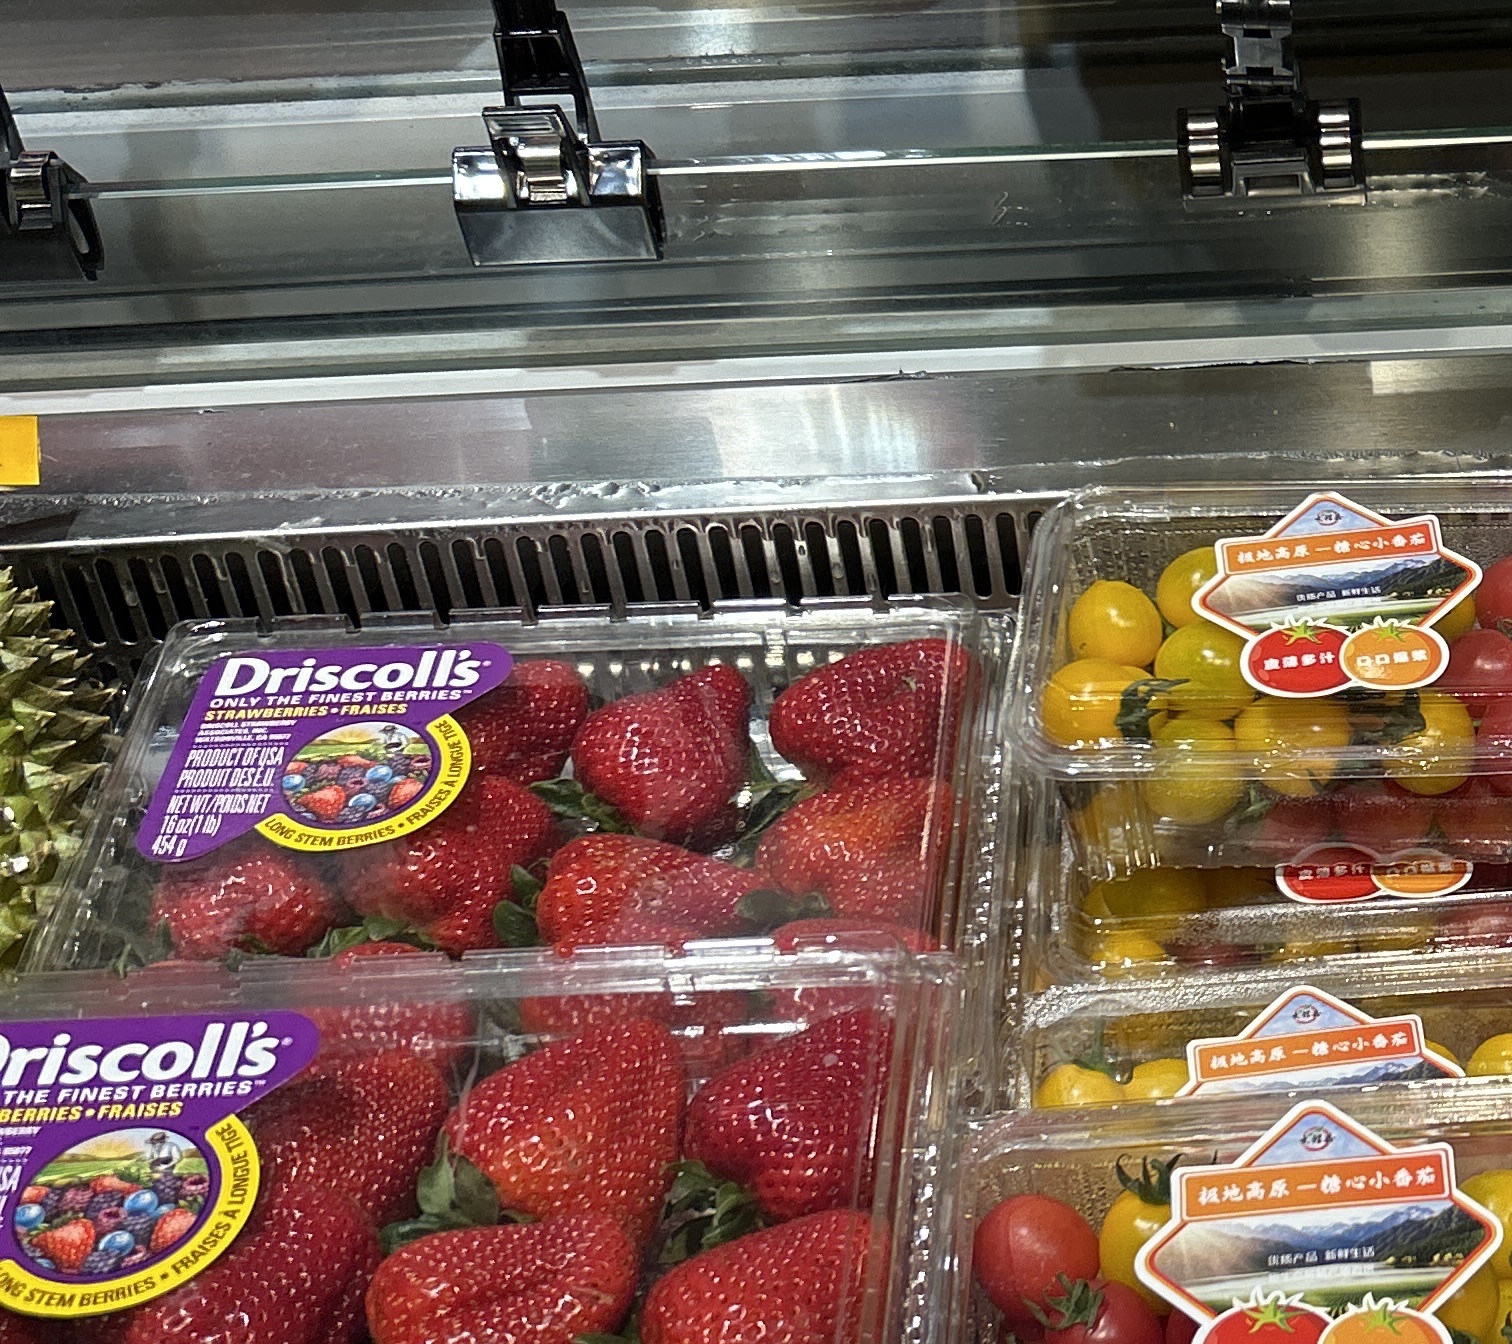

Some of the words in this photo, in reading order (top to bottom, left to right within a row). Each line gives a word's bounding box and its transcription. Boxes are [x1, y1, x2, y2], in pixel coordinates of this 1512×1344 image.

[214, 649, 482, 696] Driscoll's
[209, 697, 261, 709] ONLY
[267, 695, 305, 706] THE
[308, 692, 374, 704] FINEST
[204, 705, 329, 721] STRAWBERRIES
[339, 703, 409, 716] FRAISES
[434, 719, 459, 742] TIGE
[184, 748, 245, 768] PRODUCT
[241, 747, 261, 766] OF
[258, 747, 285, 766] USA
[449, 738, 465, 779] LONGUE
[177, 768, 233, 788] PRODUIT
[230, 767, 256, 787] DES
[166, 795, 192, 814] NET
[246, 794, 271, 814] NET
[405, 789, 451, 825] FRAISES
[264, 818, 296, 840] LONG
[336, 825, 396, 846] BERRIES
[151, 835, 178, 855] 454
[294, 833, 334, 847] STEM
[3, 1090, 50, 1105] THE
[57, 1086, 146, 1103] FINEST
[97, 1102, 183, 1121] FRAISES
[215, 1123, 245, 1154] TIGE
[230, 1149, 250, 1206] LONGUE
[171, 1221, 232, 1275] FRAISES
[23, 1288, 75, 1307] STEM
[78, 1277, 157, 1306] BERRIES
